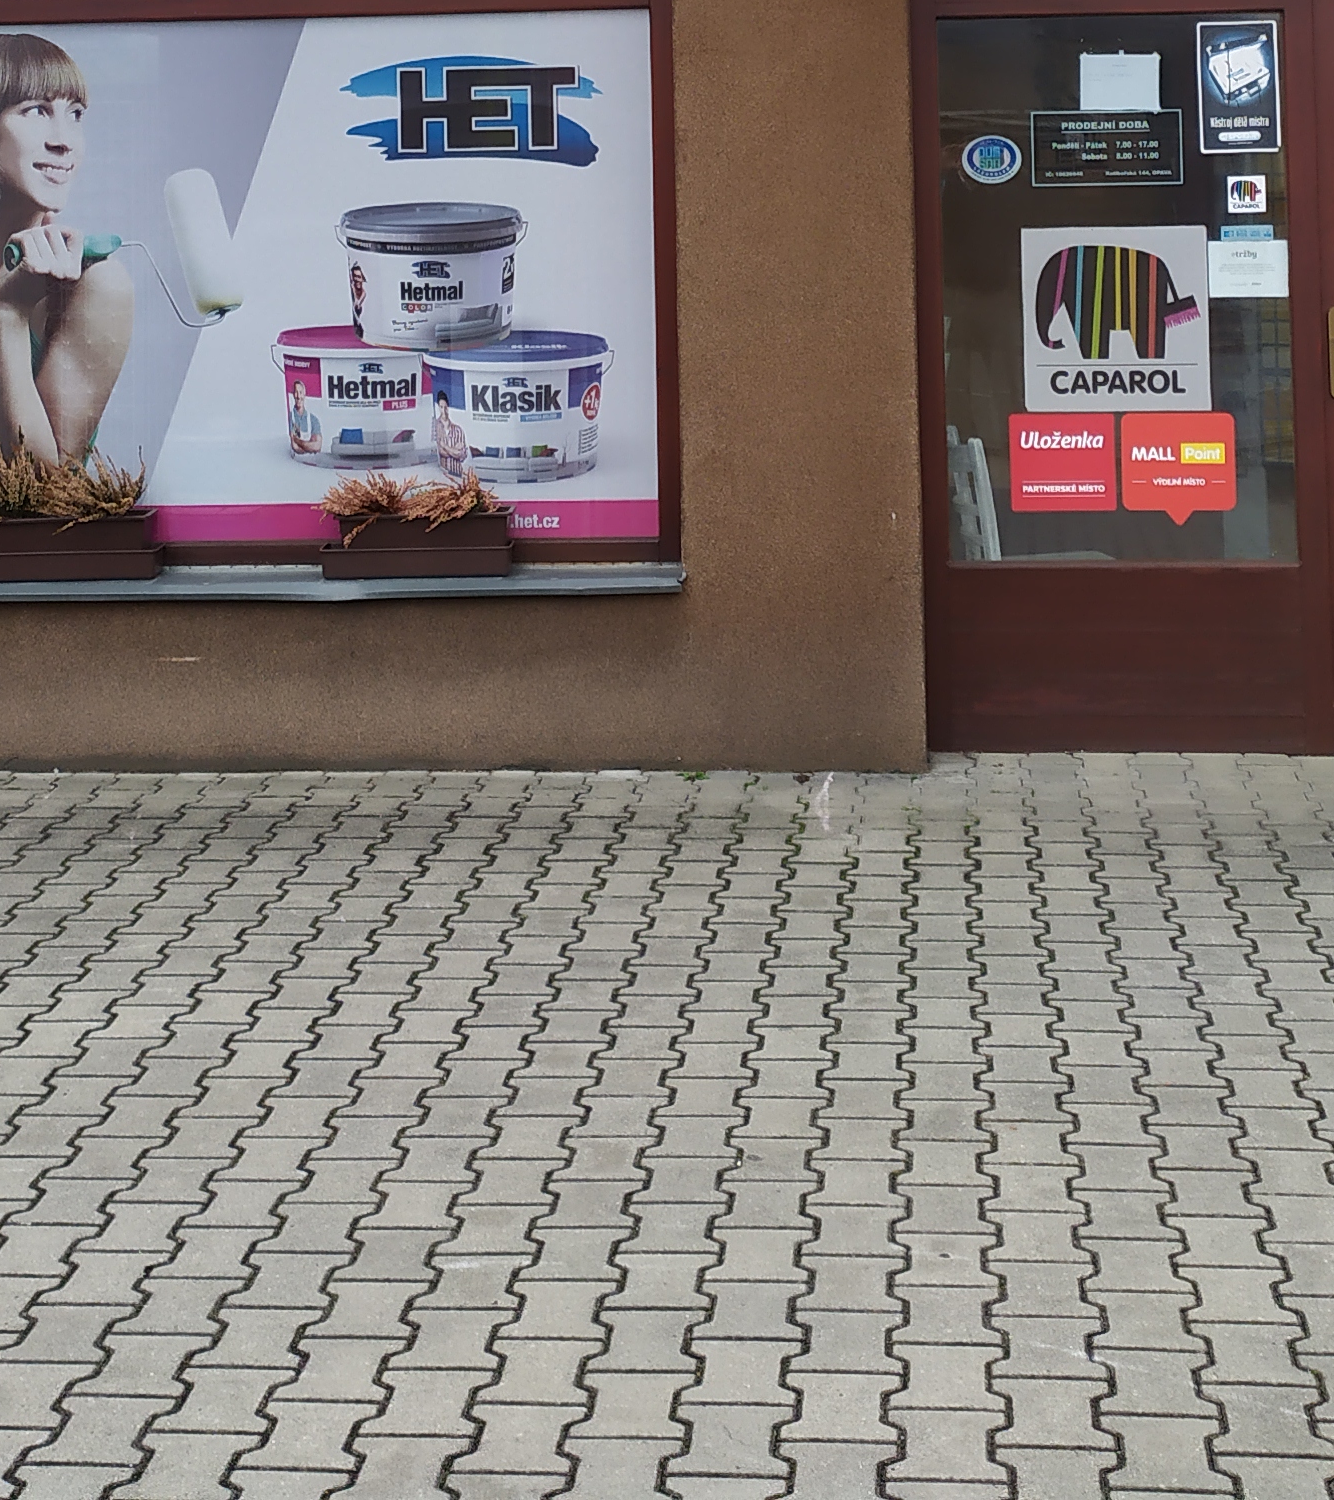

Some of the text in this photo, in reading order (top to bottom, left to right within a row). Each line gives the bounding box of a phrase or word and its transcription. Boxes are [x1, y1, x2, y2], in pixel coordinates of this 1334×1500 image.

[396, 65, 579, 152] HET
[1061, 120, 1149, 130] PRODEJNÍ DOBA
[1086, 141, 1107, 149] Pátek
[1139, 140, 1158, 148] 17.00
[418, 262, 448, 277] HET
[400, 281, 463, 301] Hetmal
[328, 373, 416, 399] Hetmal
[1050, 369, 1186, 394] CAPAROL
[471, 384, 561, 413] Klasik
[1020, 431, 1104, 449] Uloženka
[1132, 447, 1220, 461] MALL Point
[1023, 482, 1105, 493] PARTNERSKÉ MÍSTO
[1182, 477, 1205, 486] MÍSTO
